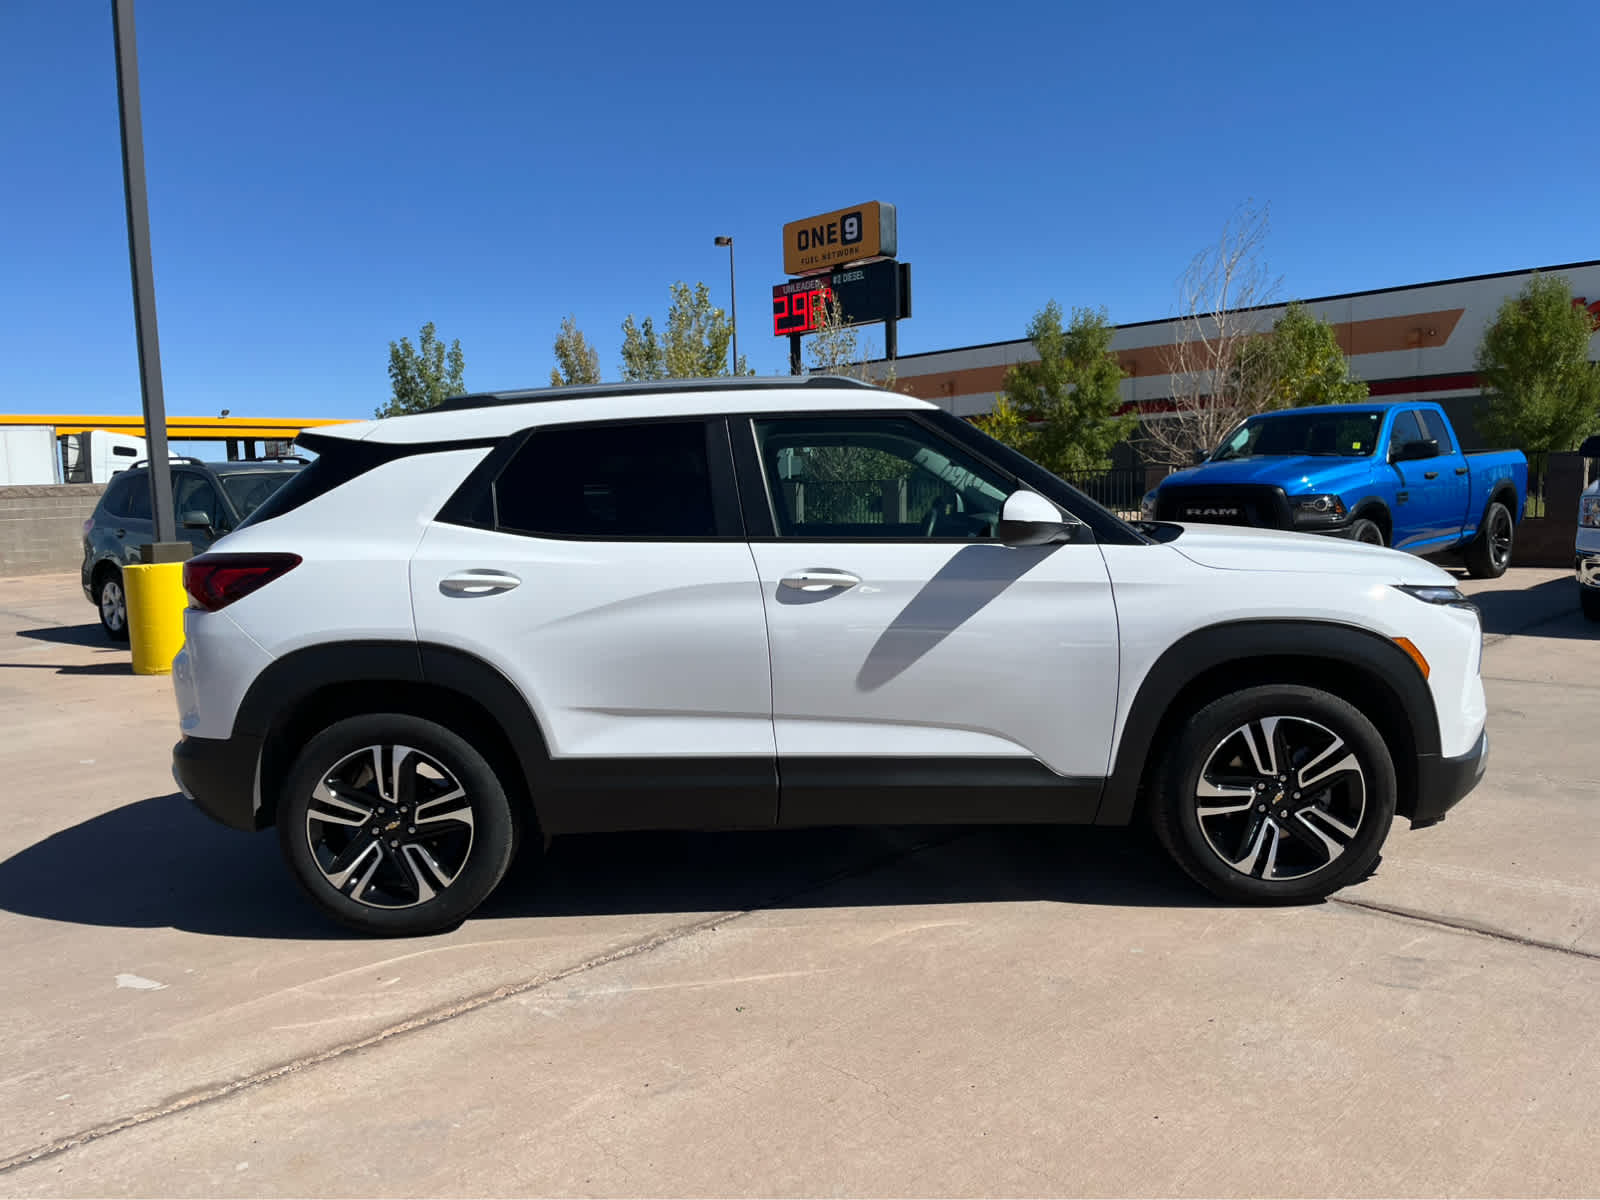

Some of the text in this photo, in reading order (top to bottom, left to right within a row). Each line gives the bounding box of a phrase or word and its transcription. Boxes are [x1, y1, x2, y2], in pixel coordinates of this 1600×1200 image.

[797, 222, 838, 251] ONE
[822, 247, 859, 260] NETWORK
[843, 271, 865, 282] DIESEL
